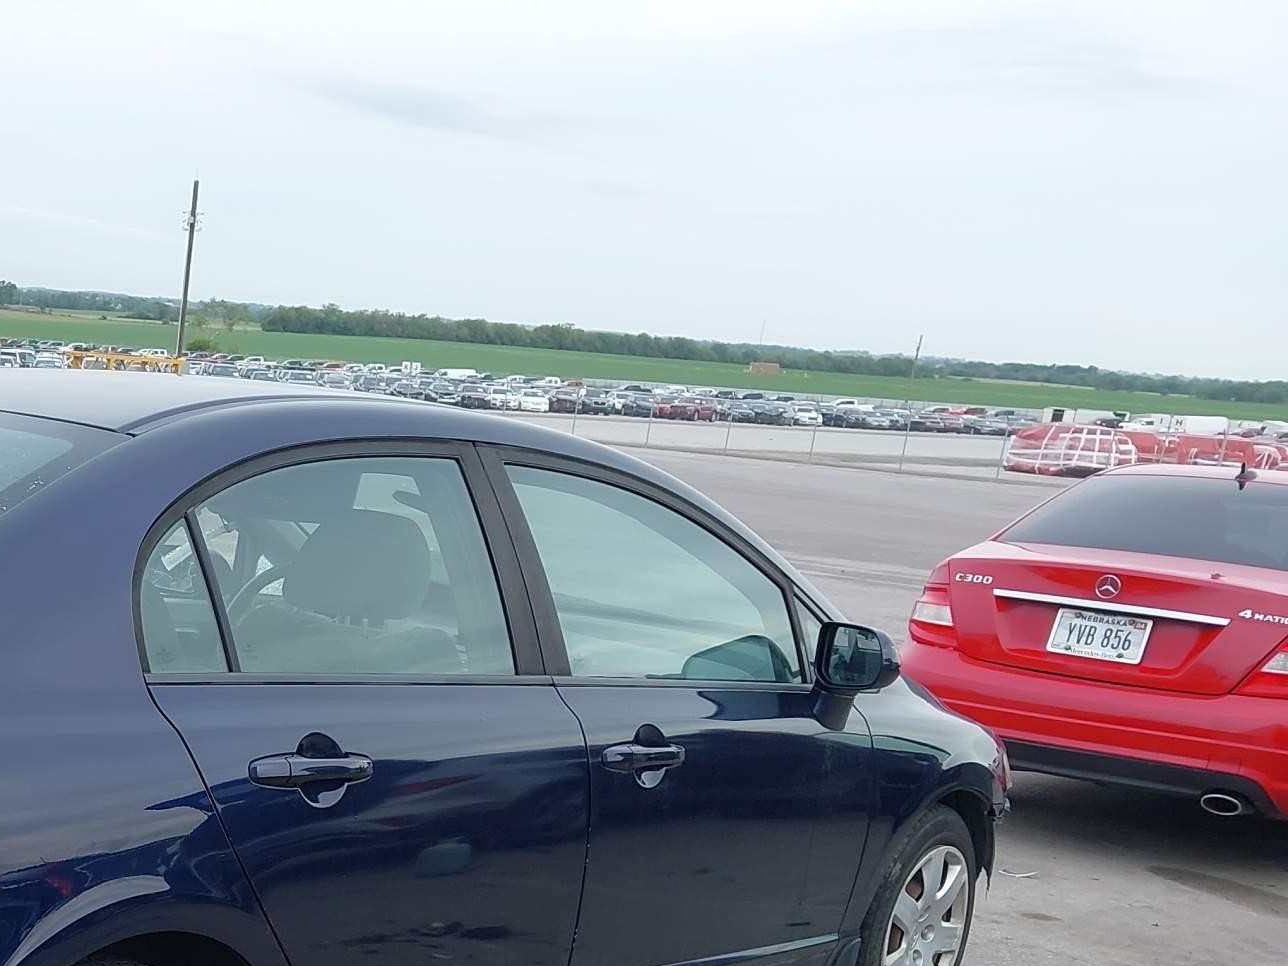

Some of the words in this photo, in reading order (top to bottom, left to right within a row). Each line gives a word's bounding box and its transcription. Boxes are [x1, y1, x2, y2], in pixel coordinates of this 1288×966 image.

[955, 572, 993, 585] C300
[1081, 614, 1128, 627] NEBRASKA
[1066, 622, 1097, 646] YVB
[1100, 628, 1132, 651] 856
